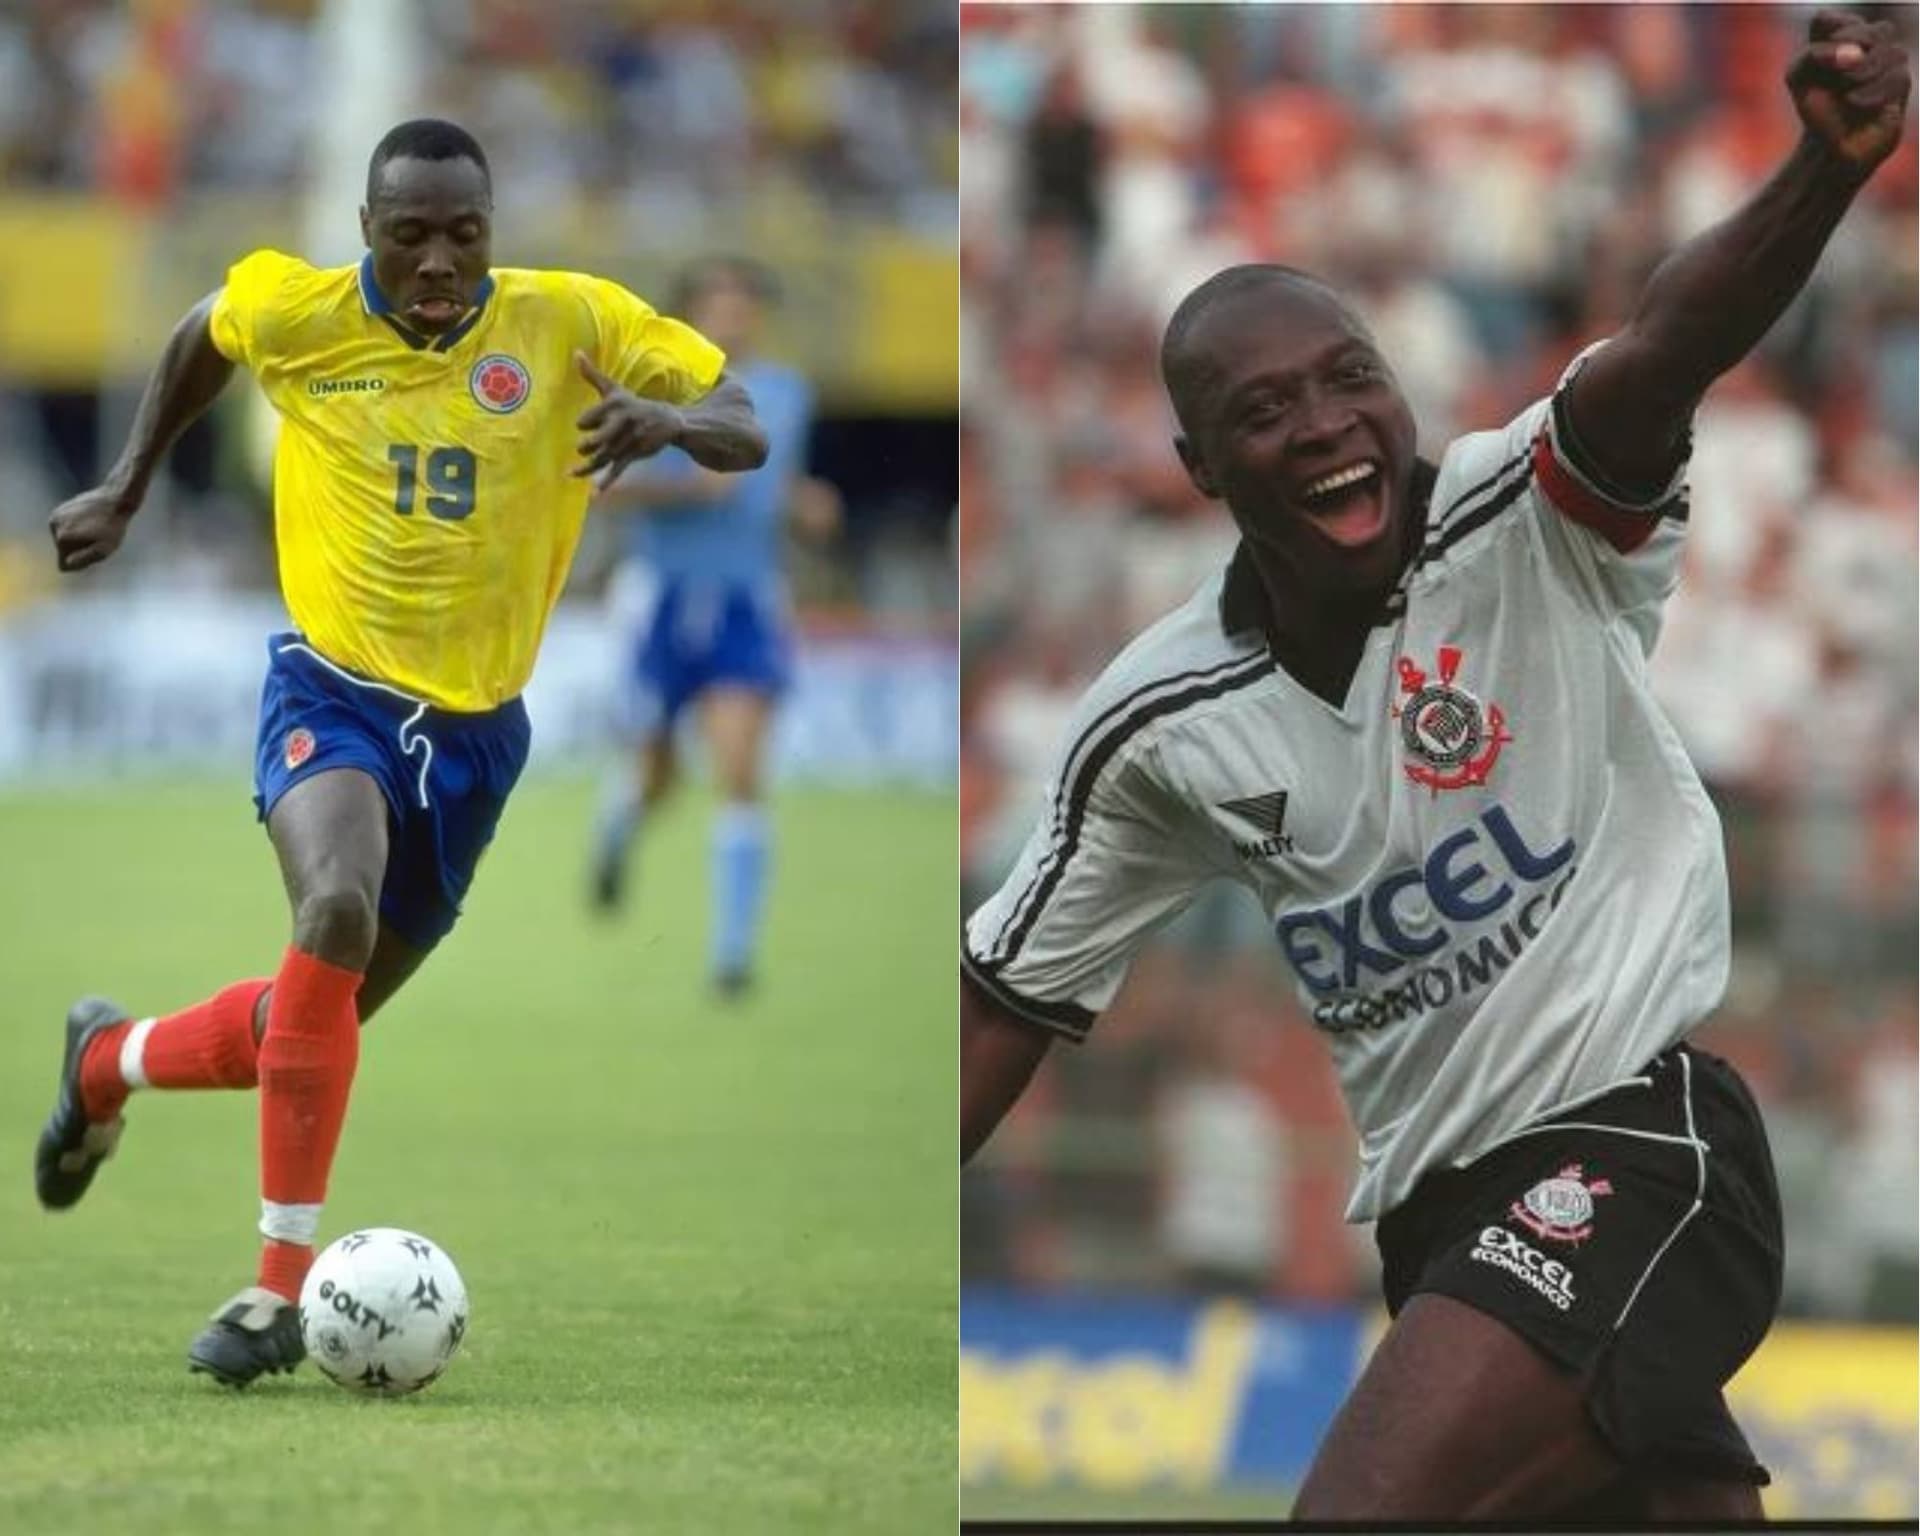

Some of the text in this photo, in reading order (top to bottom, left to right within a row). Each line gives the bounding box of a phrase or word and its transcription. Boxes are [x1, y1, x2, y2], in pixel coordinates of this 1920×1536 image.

[308, 377, 385, 396] UMBRO
[388, 444, 477, 520] 19
[1276, 803, 1576, 1000] EXCEL
[1478, 1226, 1577, 1301] EXCEL
[319, 1280, 396, 1342] GOLTY
